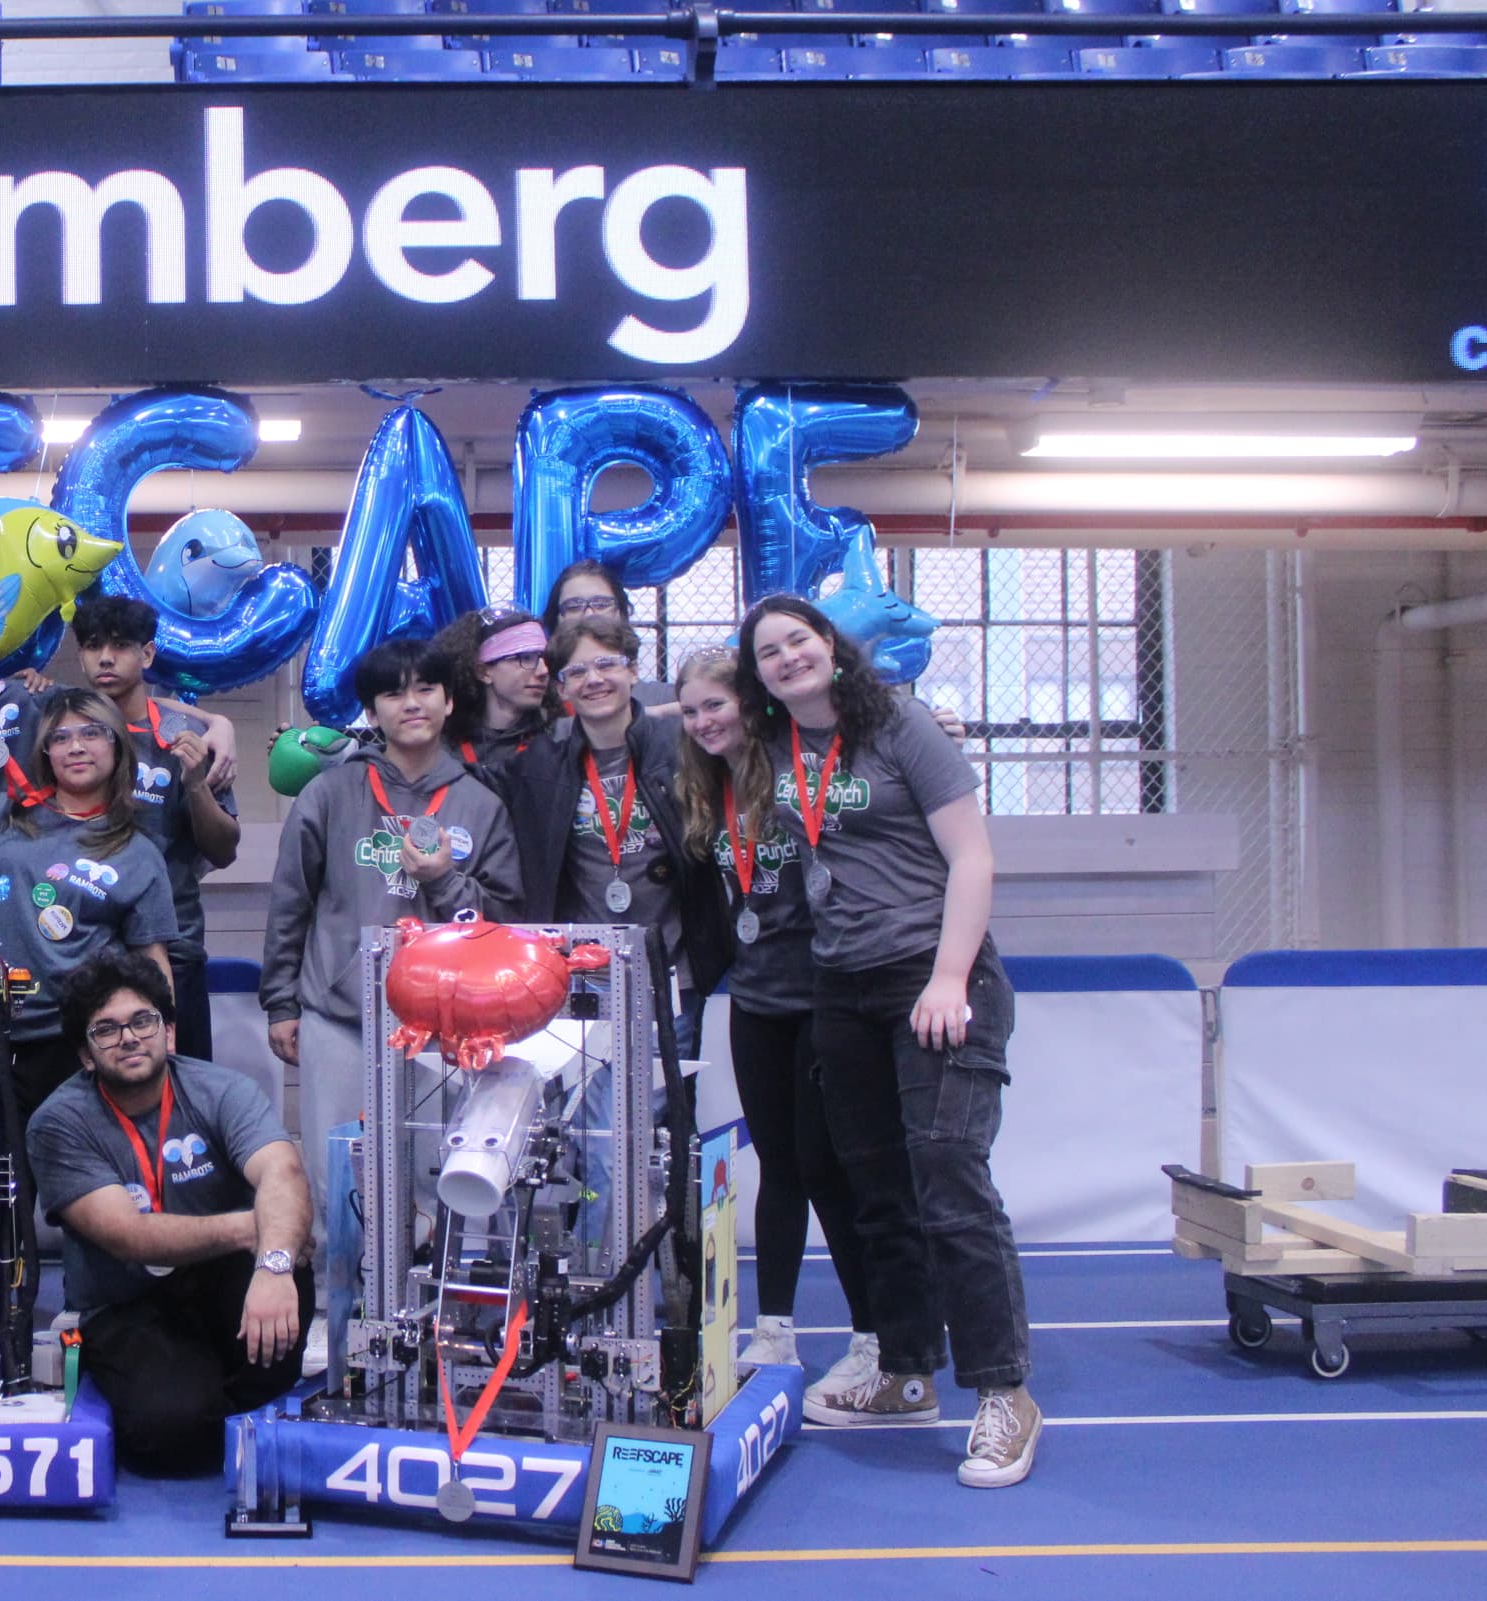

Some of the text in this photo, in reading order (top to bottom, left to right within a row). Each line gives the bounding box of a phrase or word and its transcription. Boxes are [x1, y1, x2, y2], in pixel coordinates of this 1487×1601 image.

[131, 788, 166, 805] AMBOTS
[68, 874, 107, 900] RAMBOTS
[388, 885, 417, 900] 4027
[171, 1161, 215, 1184] RAMBOTS
[613, 1446, 685, 1468] REEFSCAPE
[735, 1391, 790, 1500] 4027
[326, 1442, 582, 1520] 4027
